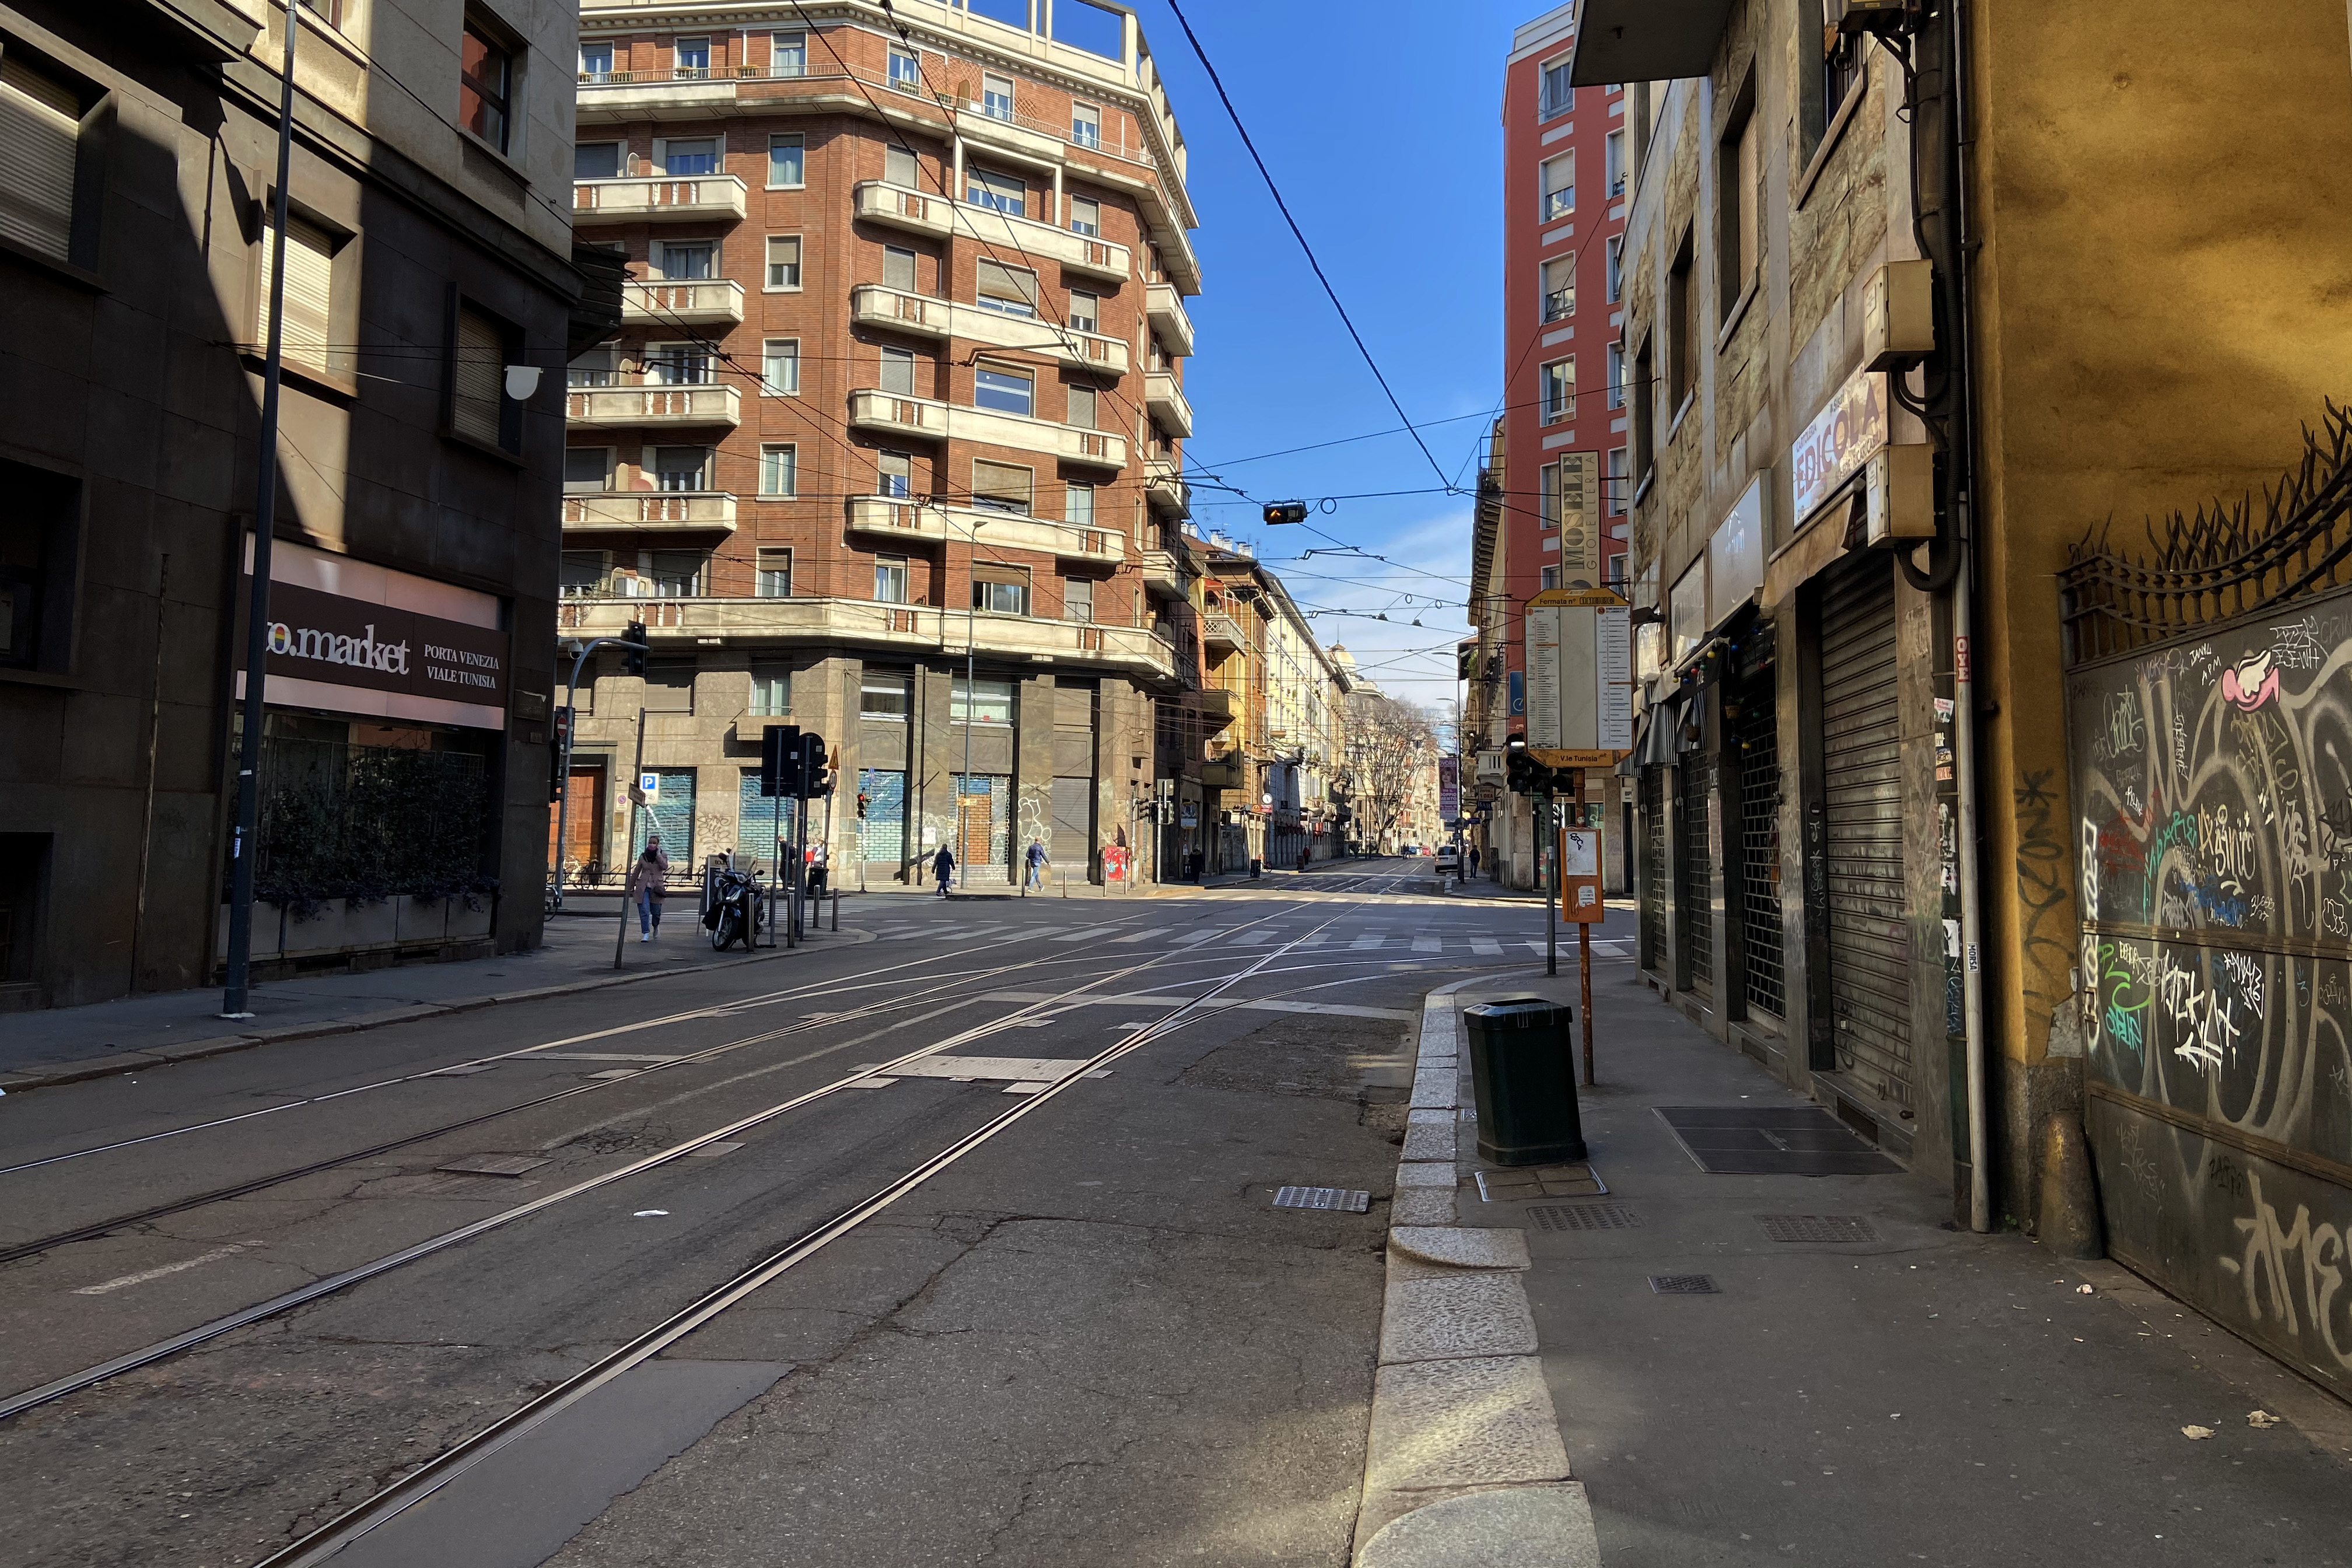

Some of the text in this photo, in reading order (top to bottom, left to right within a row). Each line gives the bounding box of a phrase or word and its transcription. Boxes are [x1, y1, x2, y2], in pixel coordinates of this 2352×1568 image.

[1797, 379, 1880, 500] EDICOLA
[1563, 456, 1584, 570] MOSELE
[1585, 456, 1597, 569] GIOIELLERIA
[267, 622, 410, 675] o.market
[424, 644, 500, 670] PORTA VENEZIA
[427, 666, 496, 689] VIALE TUNISIA
[645, 777, 653, 788] P
[1478, 801, 1491, 810] BAR
[1968, 944, 1977, 971] MORSA
